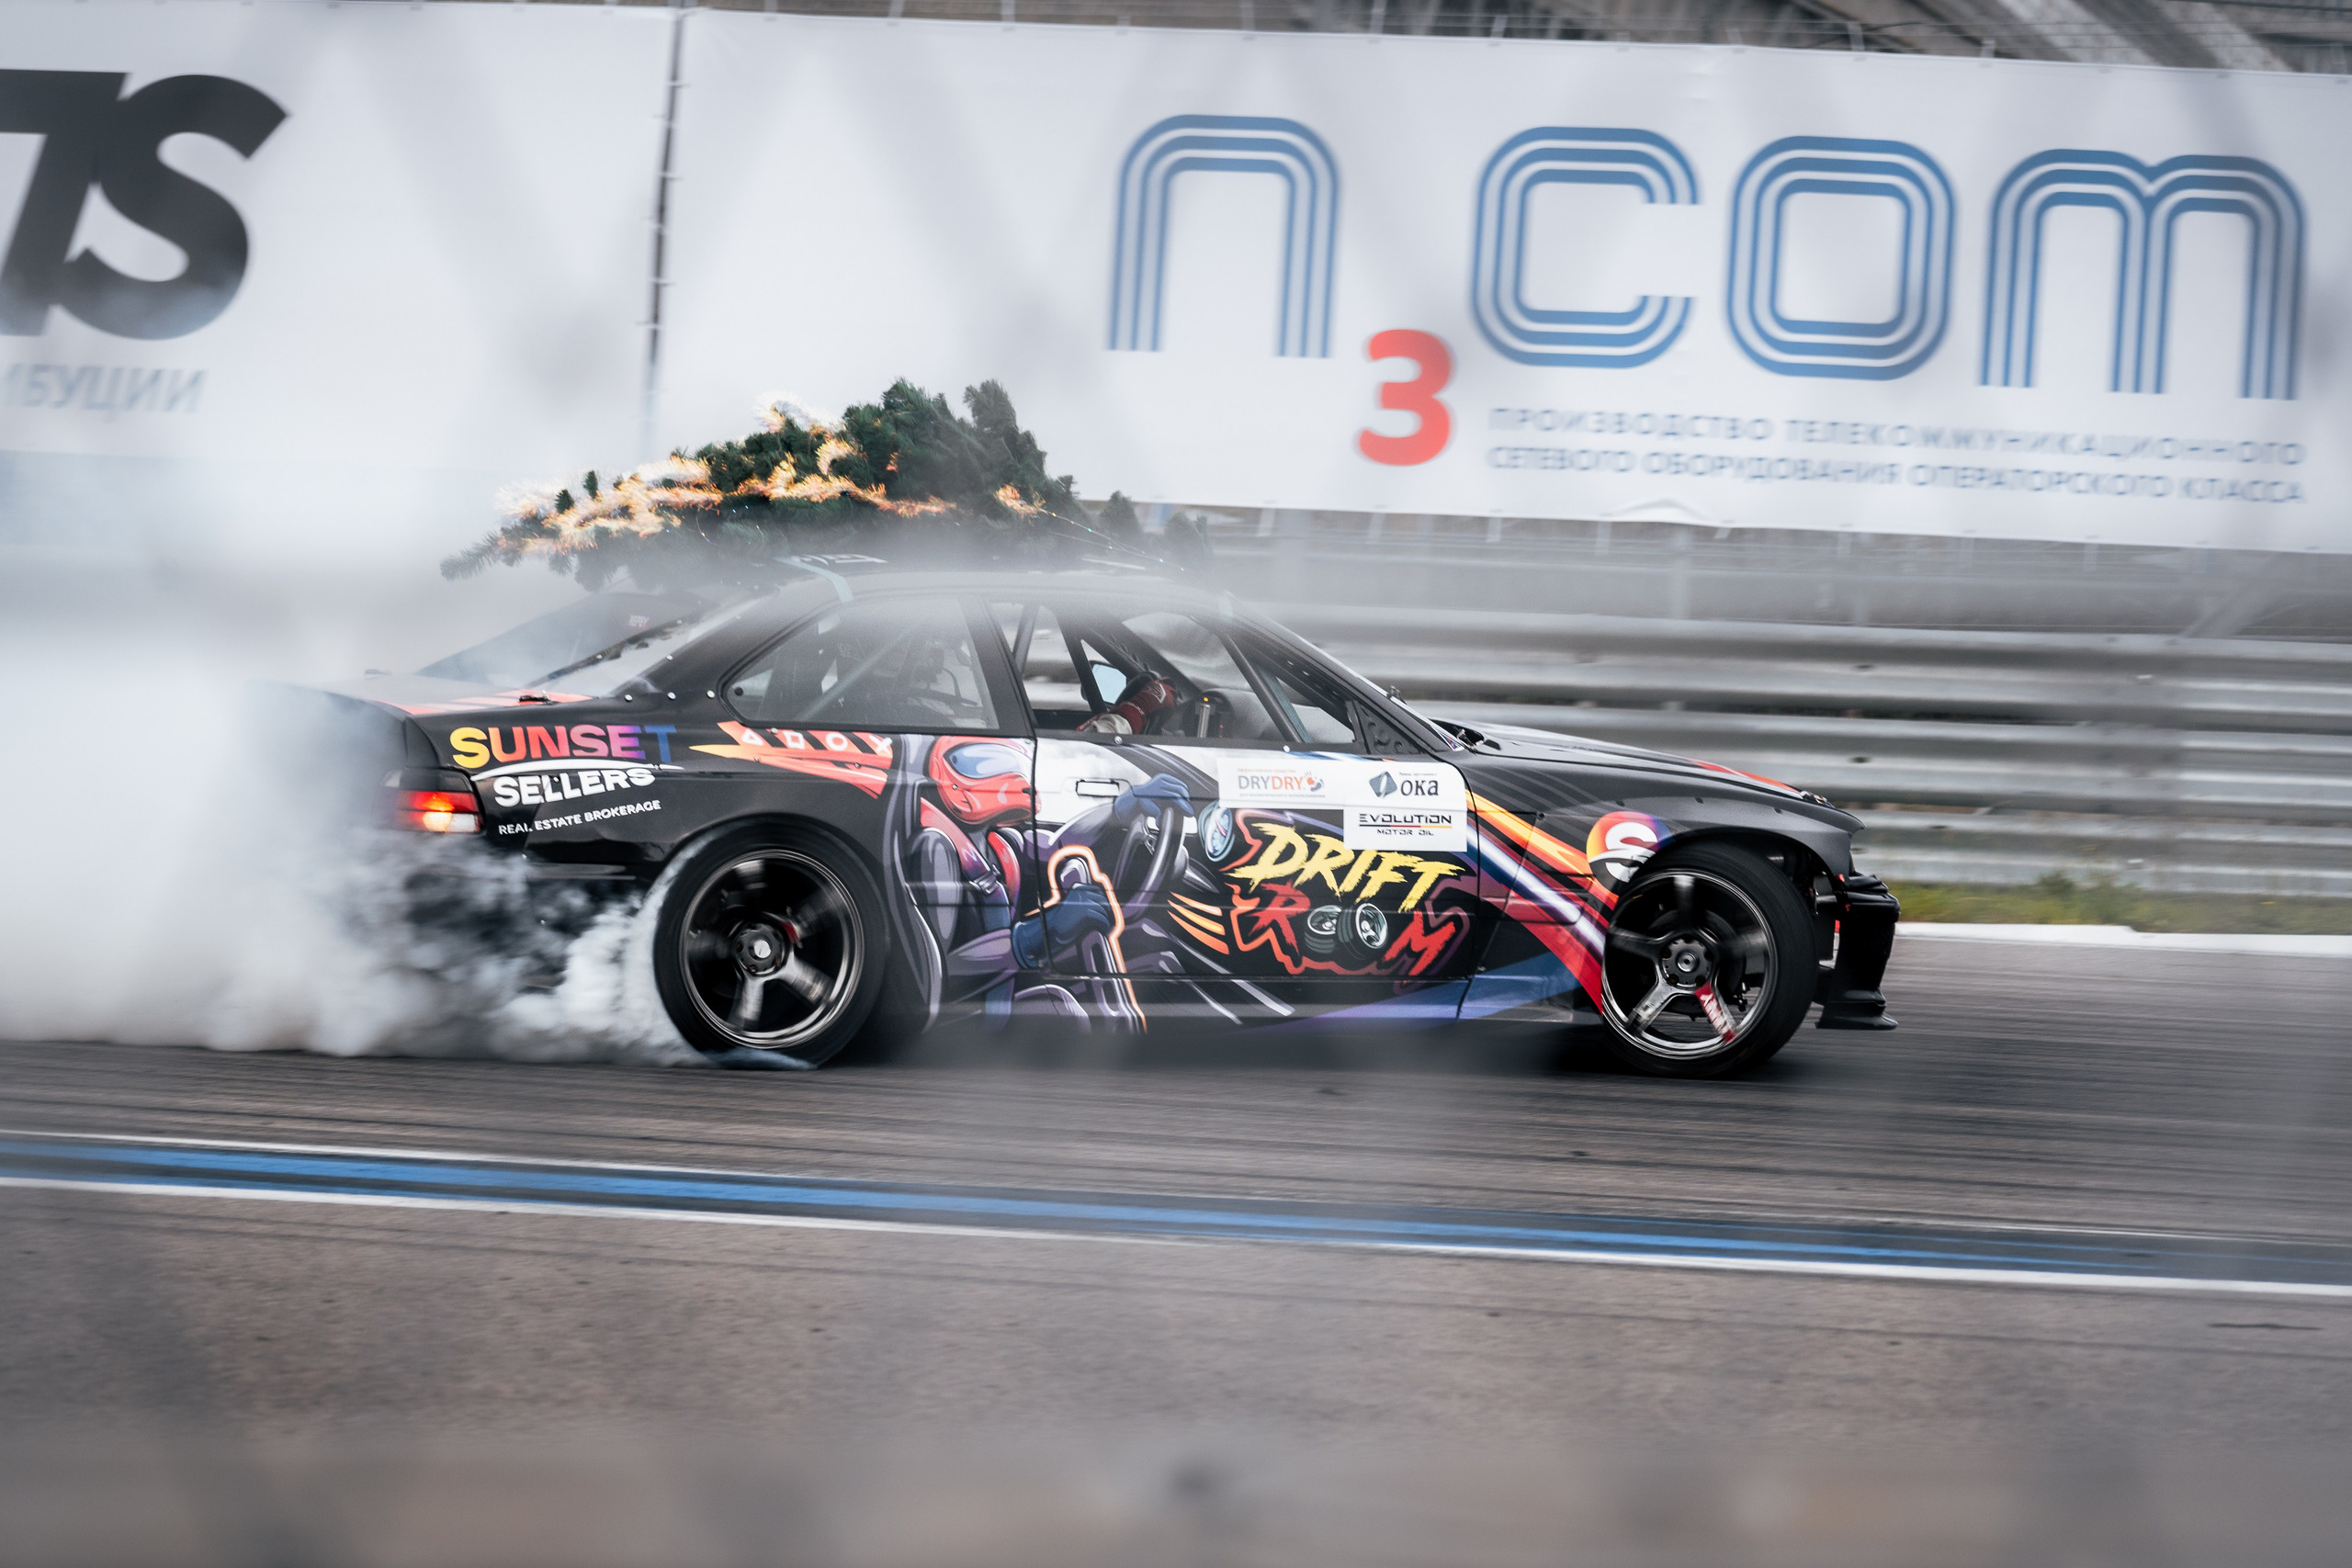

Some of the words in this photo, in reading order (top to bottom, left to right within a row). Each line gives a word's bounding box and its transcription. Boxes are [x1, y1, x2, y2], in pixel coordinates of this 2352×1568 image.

[1488, 408, 1773, 440] ПРОИЗВОДСТВО
[1784, 419, 2305, 464] ТЕЛЕКОММУНИКАЦИОННОГО
[1487, 446, 1635, 472] СЕТЕВОГО
[1641, 451, 1903, 484] ОБОРУДОВАНИЯ
[1906, 463, 2174, 498] ОПЕРАТОРСКОГО
[2177, 478, 2307, 504] КЛАССА
[450, 724, 677, 769] SUNSET
[492, 767, 656, 807] SELLERS
[1238, 774, 1303, 791] DRYDRY
[498, 822, 533, 835] REAL
[535, 814, 582, 831] ESTATE
[584, 799, 662, 823] BROKERAGE
[1359, 813, 1453, 824] EVOLUTION
[1225, 822, 1465, 914] DRIFT
